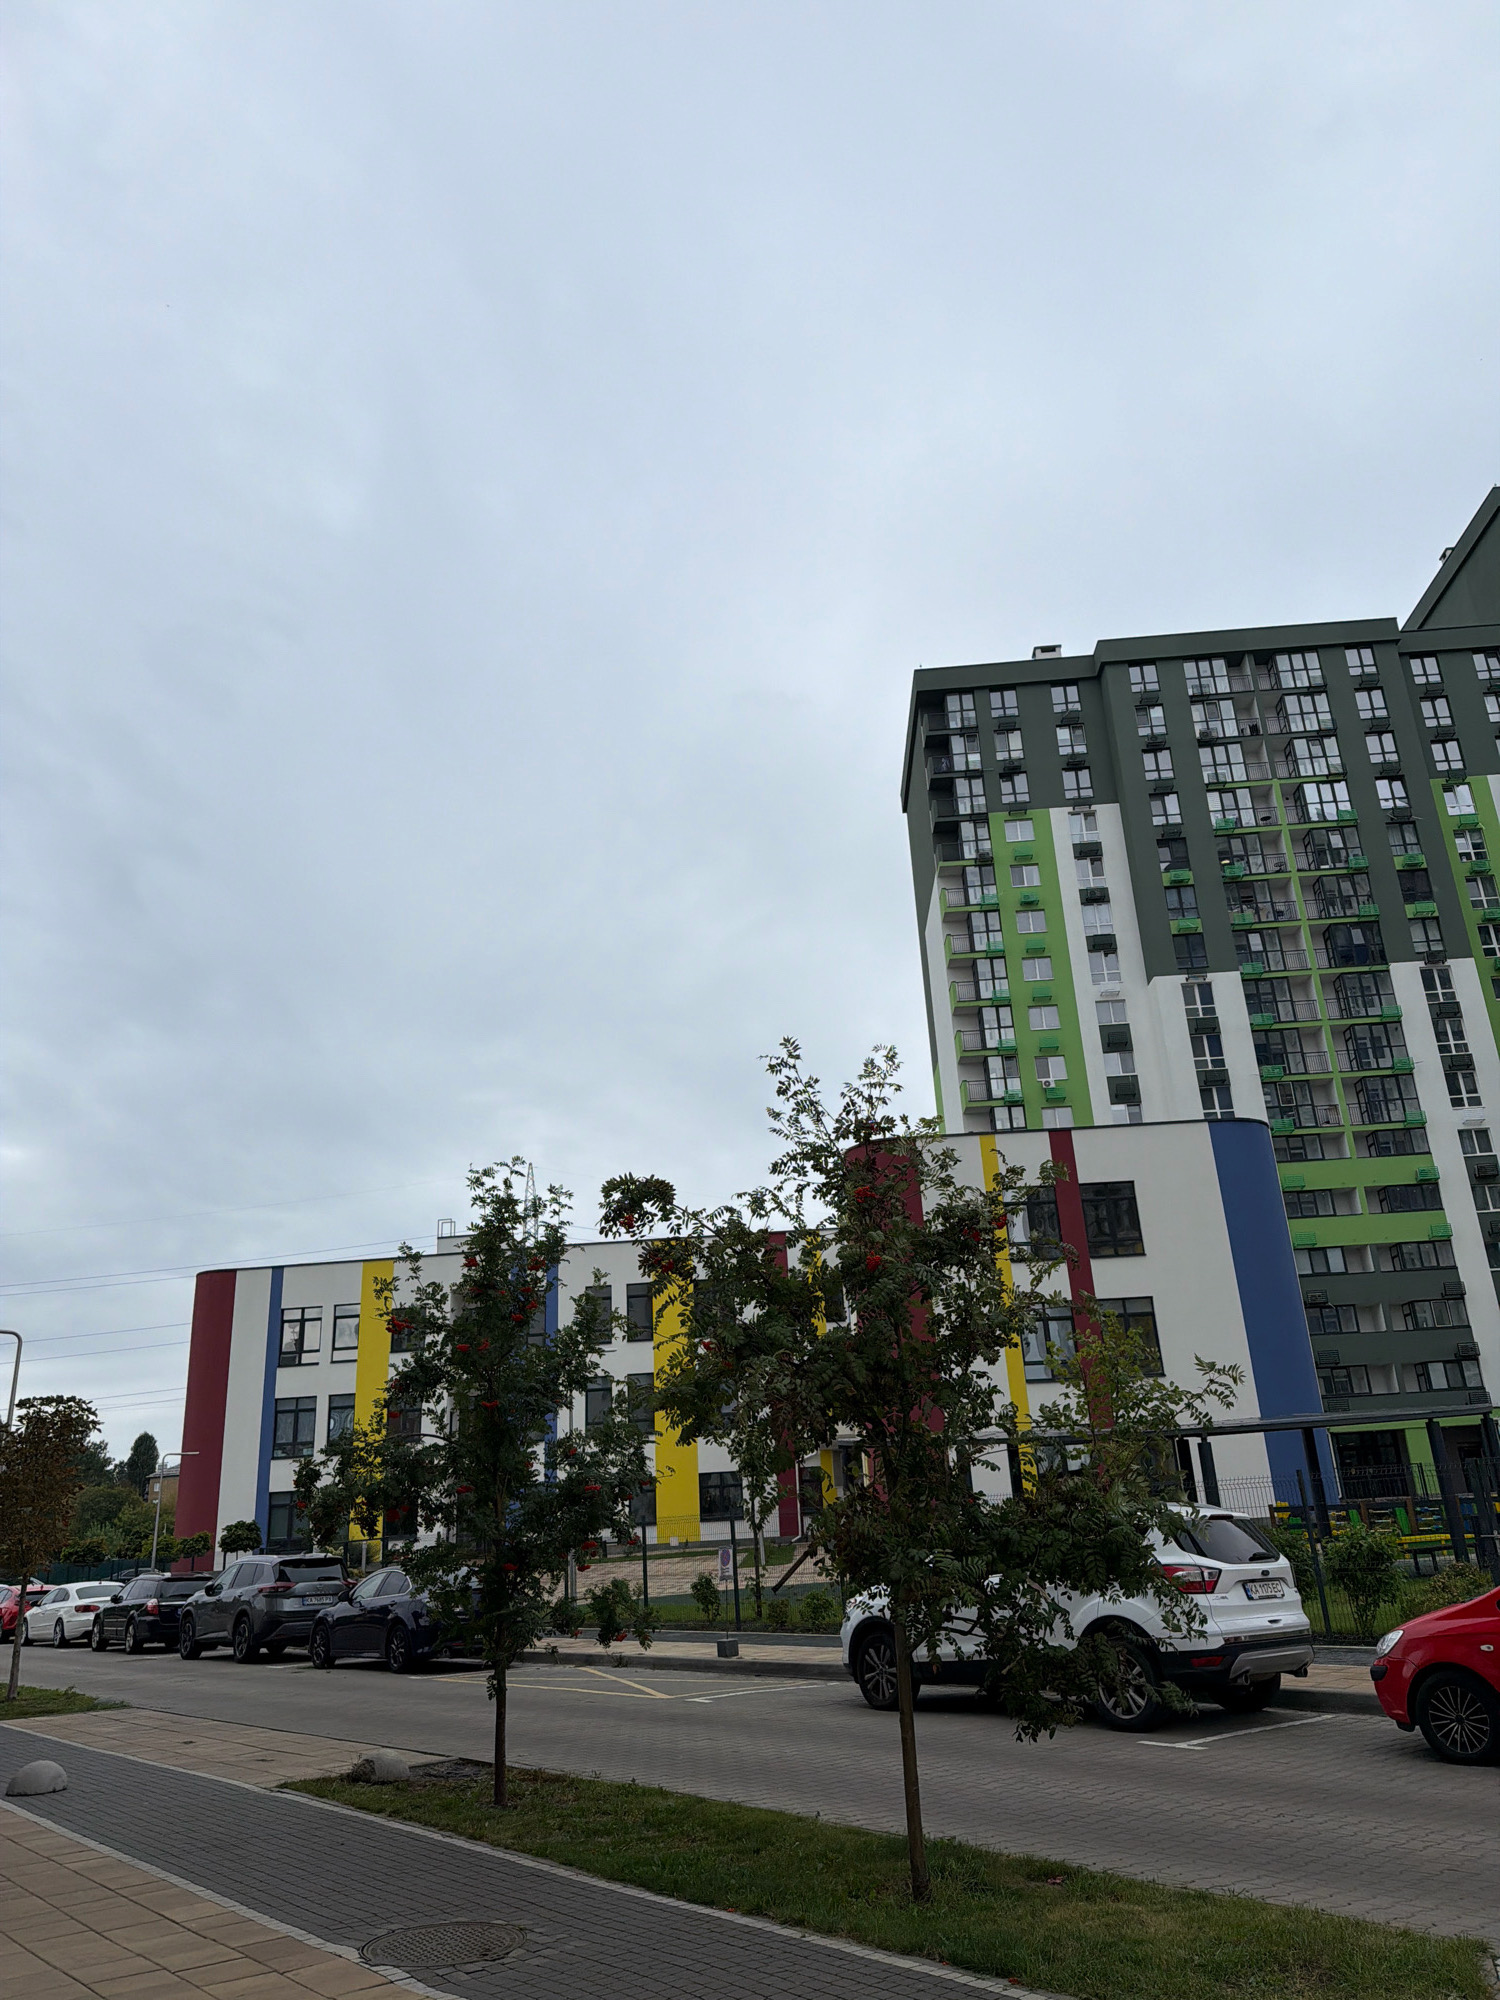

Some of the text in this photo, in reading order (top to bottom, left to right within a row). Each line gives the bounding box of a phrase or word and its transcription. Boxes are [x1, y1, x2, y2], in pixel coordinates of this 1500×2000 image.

[1250, 1582, 1282, 1595] KA 1175 EC
